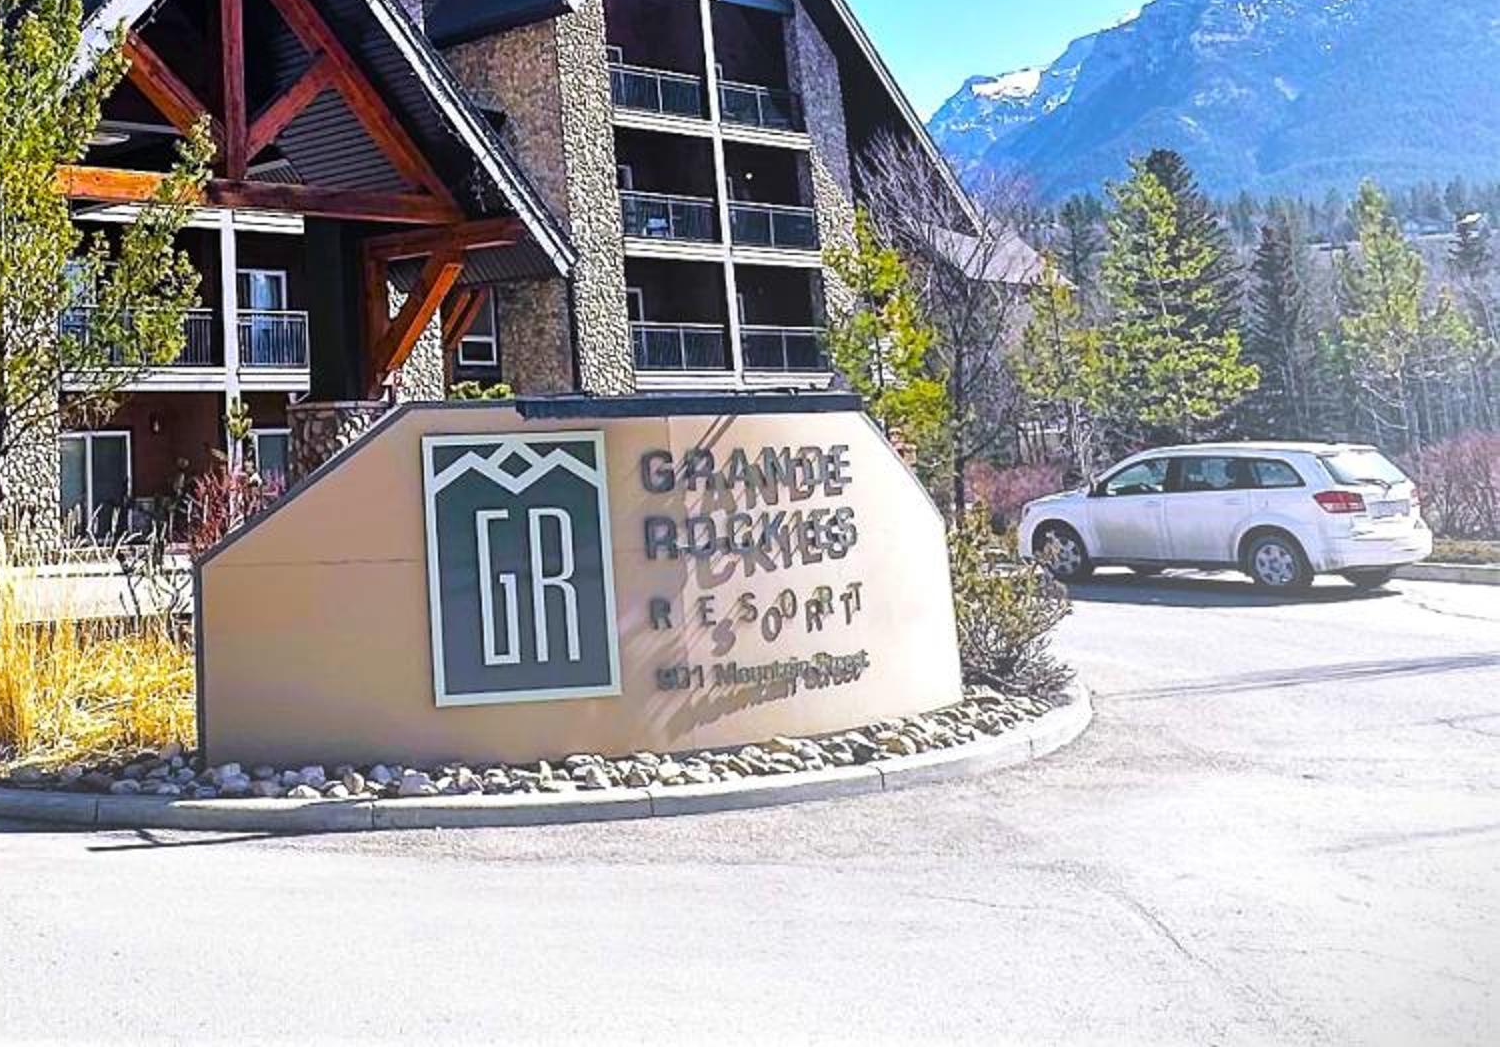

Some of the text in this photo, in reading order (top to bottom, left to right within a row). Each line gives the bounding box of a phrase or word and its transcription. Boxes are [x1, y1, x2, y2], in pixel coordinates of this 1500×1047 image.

[641, 444, 852, 494] GRANDE
[644, 507, 857, 561] ROCKIES
[475, 507, 581, 666] GR
[648, 581, 863, 631] RESORT
[712, 656, 809, 685] Mountain
